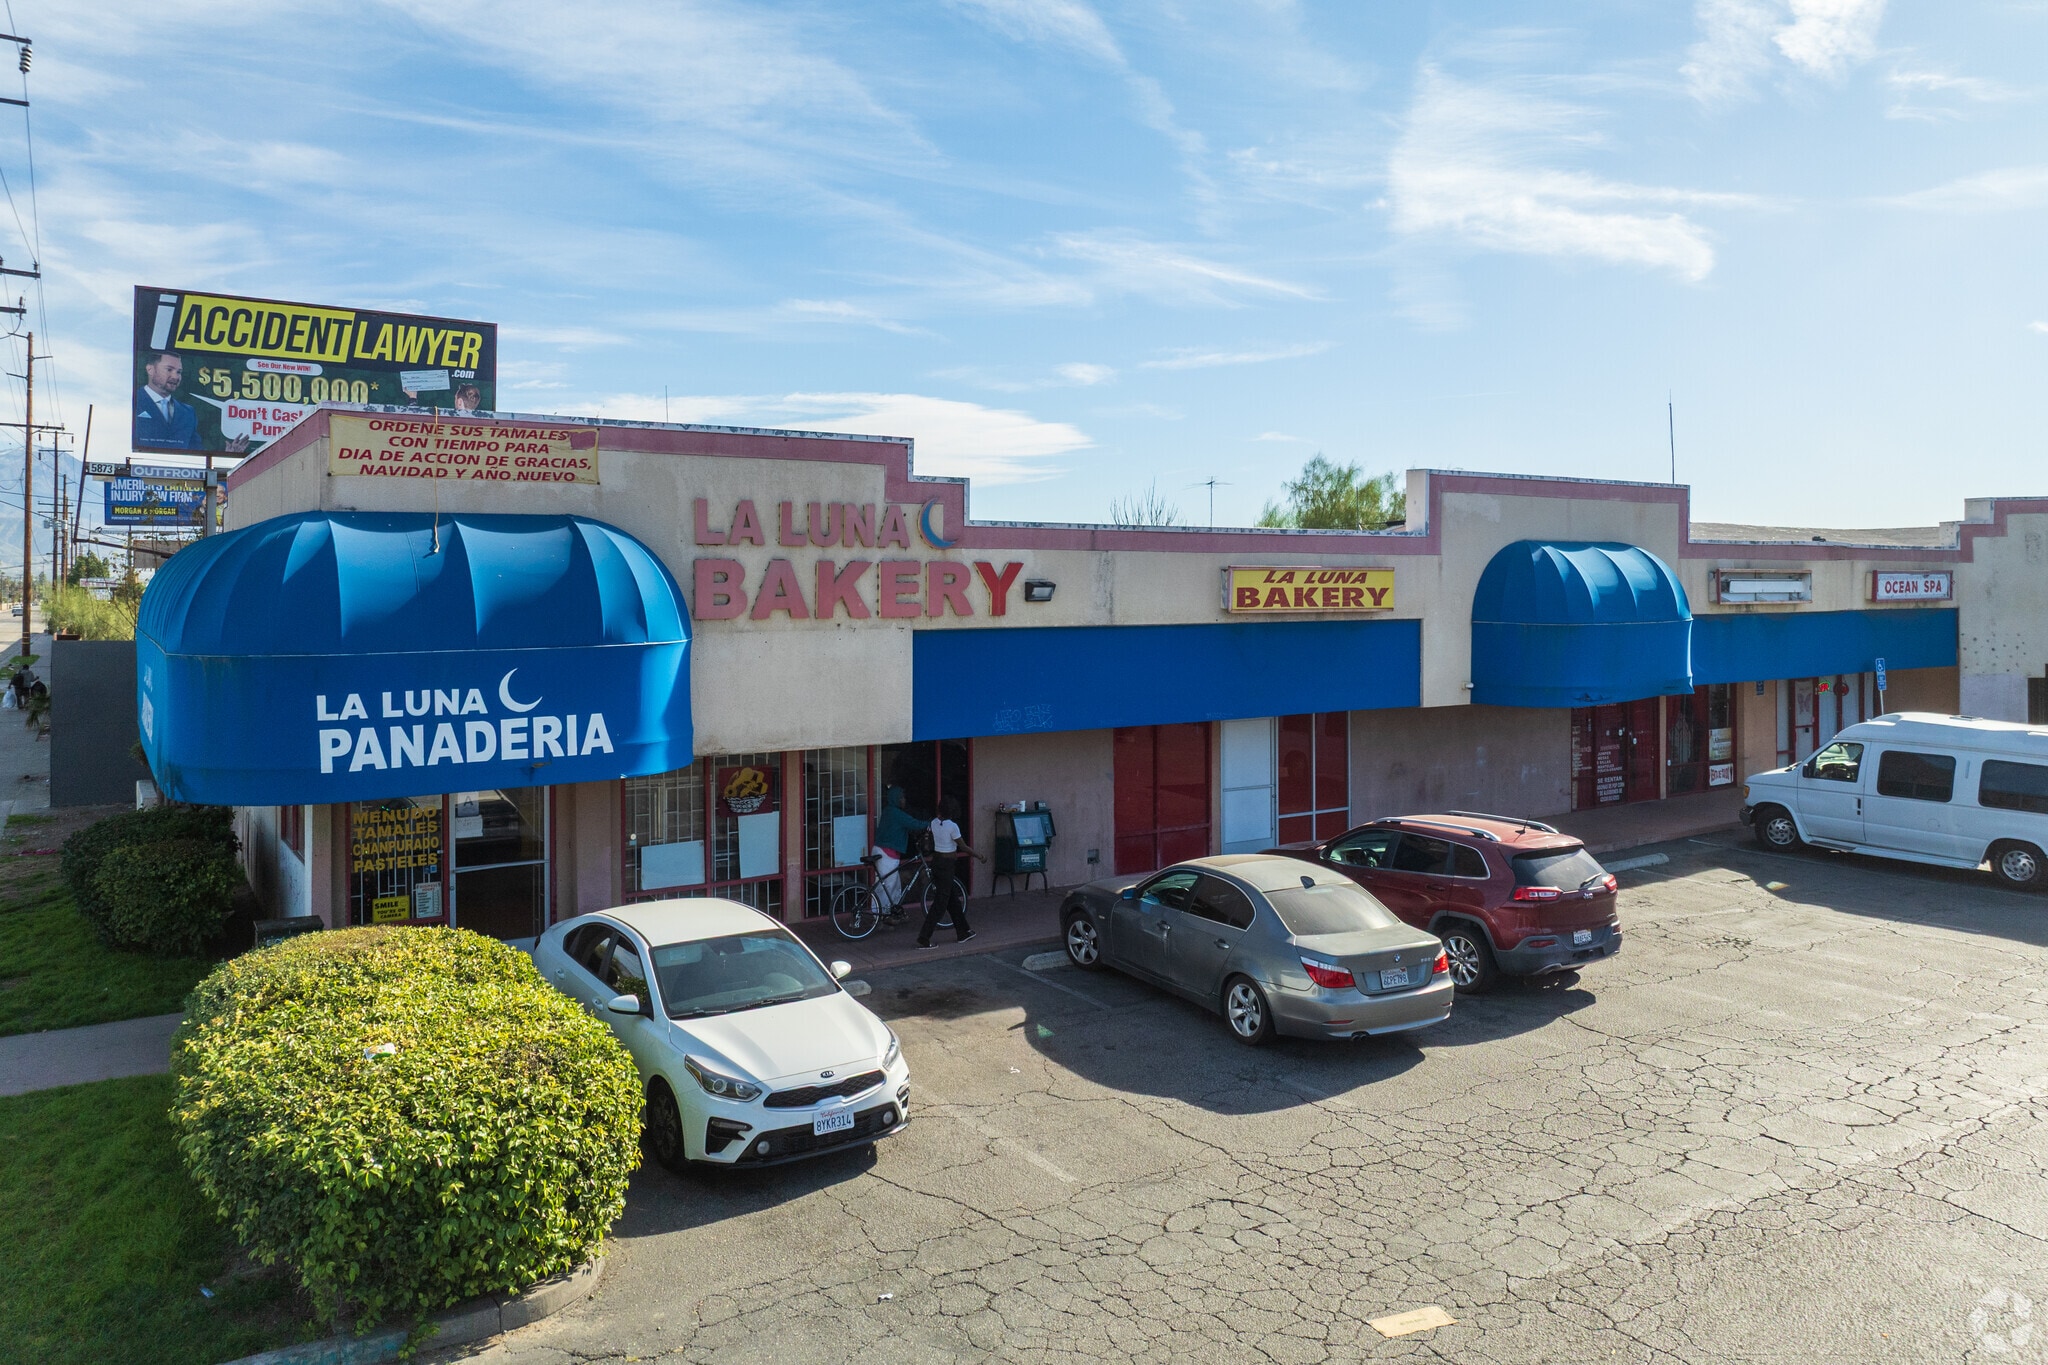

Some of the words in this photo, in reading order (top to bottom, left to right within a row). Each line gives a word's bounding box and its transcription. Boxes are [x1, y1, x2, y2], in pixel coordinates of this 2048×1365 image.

[451, 369, 475, 379] .com
[228, 405, 267, 420] Don't
[252, 421, 286, 437] Pun
[369, 420, 445, 435] ORDENE
[450, 425, 483, 437] SUS
[490, 427, 569, 441] TAMALES
[388, 436, 428, 448] CON
[434, 438, 499, 452] TIEMPO
[504, 442, 550, 454] PARA
[338, 448, 373, 460] DIA
[379, 450, 405, 462] DE
[409, 452, 480, 465] ACCION
[485, 456, 509, 467] DE
[514, 456, 592, 470] GRACIAS,
[91, 463, 113, 474] 5873
[134, 466, 207, 479] OUTFRONT
[360, 464, 448, 479] NAVIDAD
[455, 468, 468, 479] Y
[471, 466, 511, 481] AÑO
[517, 470, 576, 482] NUEVO
[111, 490, 145, 502] INJURY
[170, 491, 193, 503] FIRM
[114, 506, 142, 515] MORGAN
[694, 497, 765, 546] LA
[778, 501, 911, 548] LUNA
[1263, 570, 1296, 584] LA
[1304, 571, 1368, 585] LUNA
[693, 558, 1024, 620] BAKERY
[1884, 580, 1918, 594] OCEAN
[1924, 580, 1942, 593] SPA
[1236, 587, 1390, 608] BAKERY
[316, 693, 369, 721] LA
[382, 688, 488, 718] LUNA
[319, 713, 615, 774] PANADERIA
[464, 795, 474, 806] A
[353, 806, 437, 825] MENUDO
[354, 821, 438, 840] TAMALES
[352, 836, 439, 856] CHANPURADO
[353, 853, 438, 873] PASTELES
[374, 901, 399, 910] SMILE
[816, 1114, 852, 1132] 8YKR314
